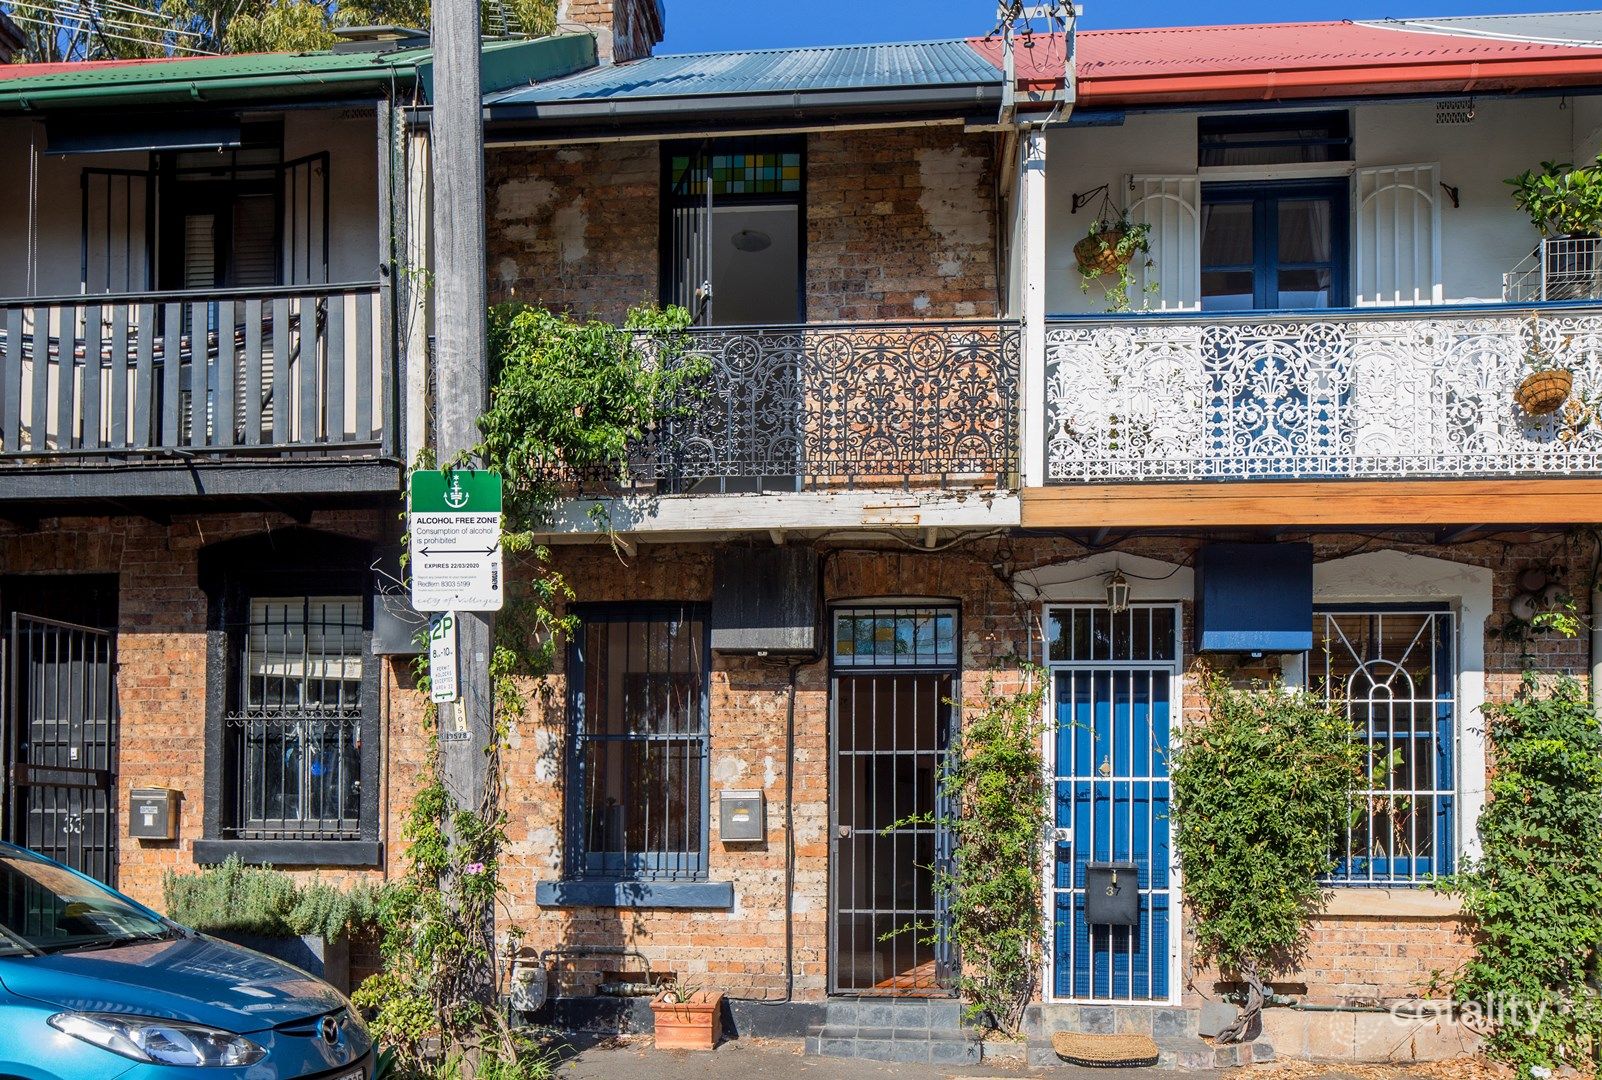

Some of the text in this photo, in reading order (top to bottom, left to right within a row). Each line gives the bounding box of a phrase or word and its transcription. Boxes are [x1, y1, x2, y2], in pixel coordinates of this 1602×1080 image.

[476, 516, 498, 524] ZONE
[416, 527, 460, 536] Consumption
[461, 527, 469, 535] of
[423, 537, 457, 545] prohibited
[432, 616, 453, 640] 2P
[63, 816, 85, 834] 33
[1106, 886, 1121, 896] 37
